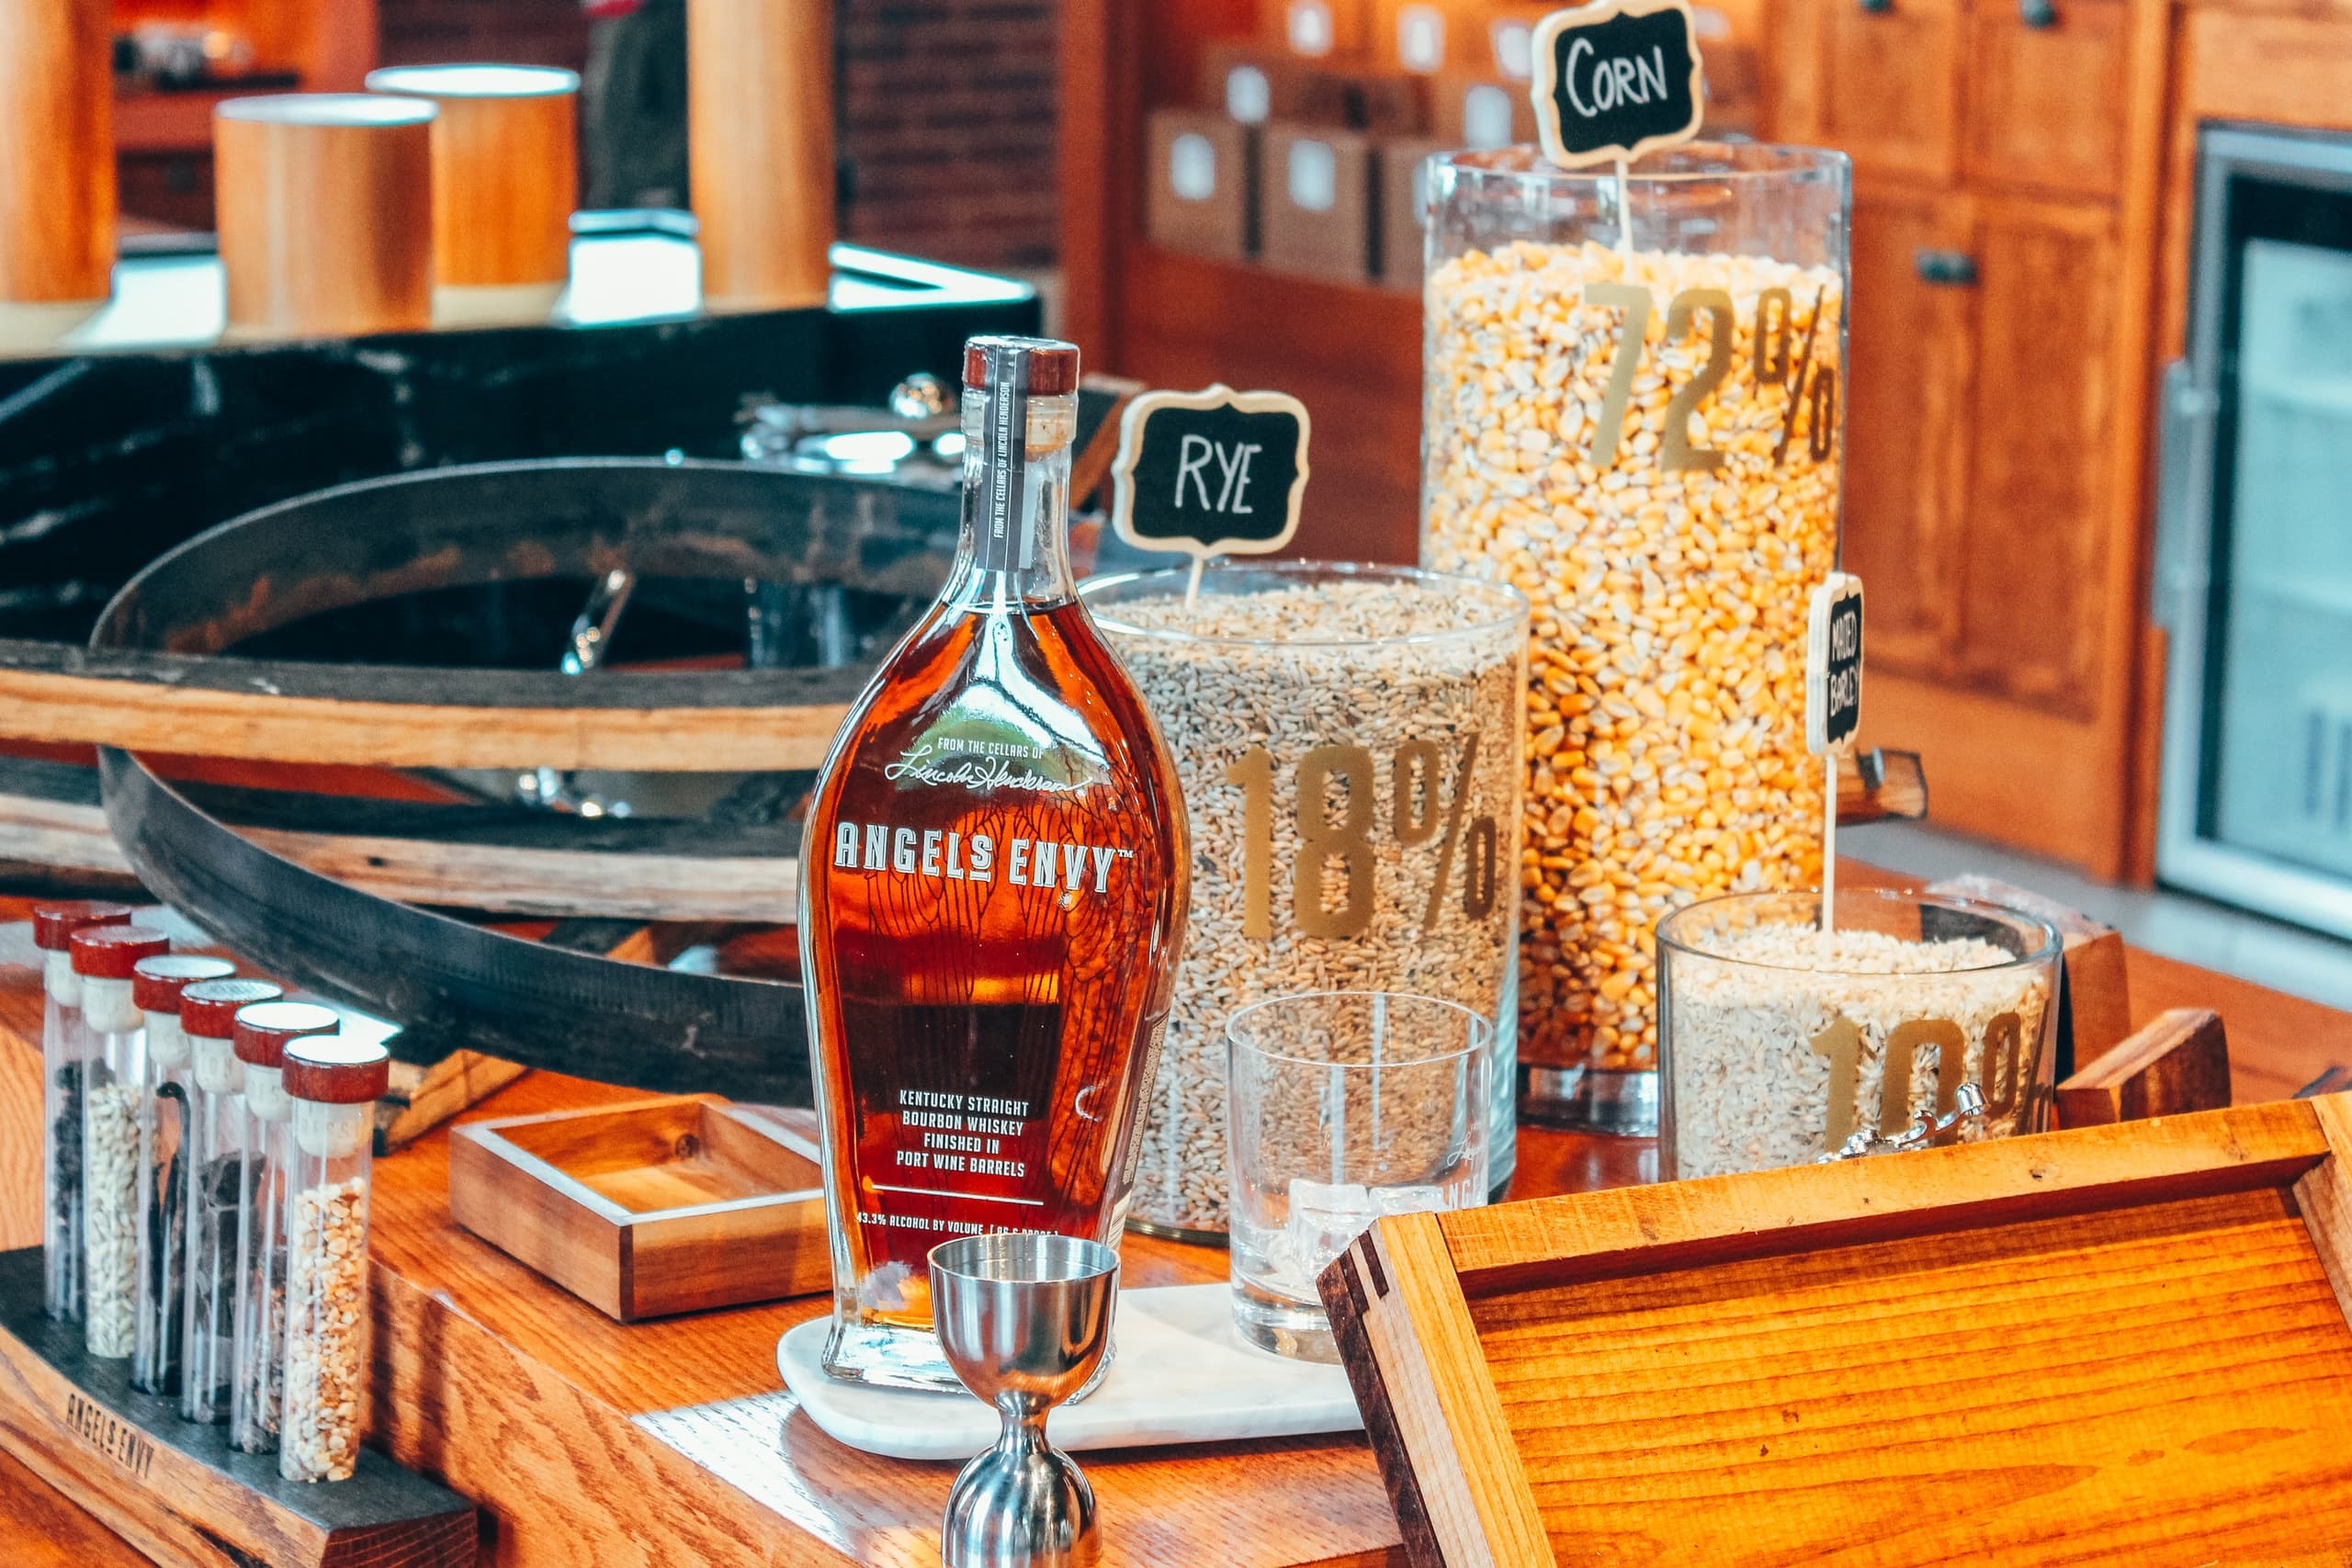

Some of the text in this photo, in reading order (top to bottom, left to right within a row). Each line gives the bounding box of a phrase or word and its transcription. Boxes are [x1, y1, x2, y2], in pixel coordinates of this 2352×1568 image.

[1566, 37, 1668, 118] CORN
[1583, 284, 1836, 472] 72%
[993, 381, 1010, 538] FROM THE CELLARS OF LINCOLN HENDERSON
[1174, 434, 1262, 513] RYE
[937, 737, 1044, 760] FROM THE CELLARS OF
[833, 821, 994, 883] ANGELS
[1227, 732, 1497, 939] 18%
[899, 1089, 1030, 1117] KENTUCKY STRAIGHT
[1809, 998, 2052, 1154] 10%
[902, 1111, 1023, 1137] BOURBON WHISKEY
[923, 1133, 1001, 1155] FINISHED IN
[897, 1150, 1025, 1178] PORT WINE BARRELS
[856, 1212, 887, 1225] 43.3%
[889, 1215, 930, 1230] ALCOHOL
[933, 1219, 945, 1232] BY
[947, 1221, 984, 1235] VOLUME
